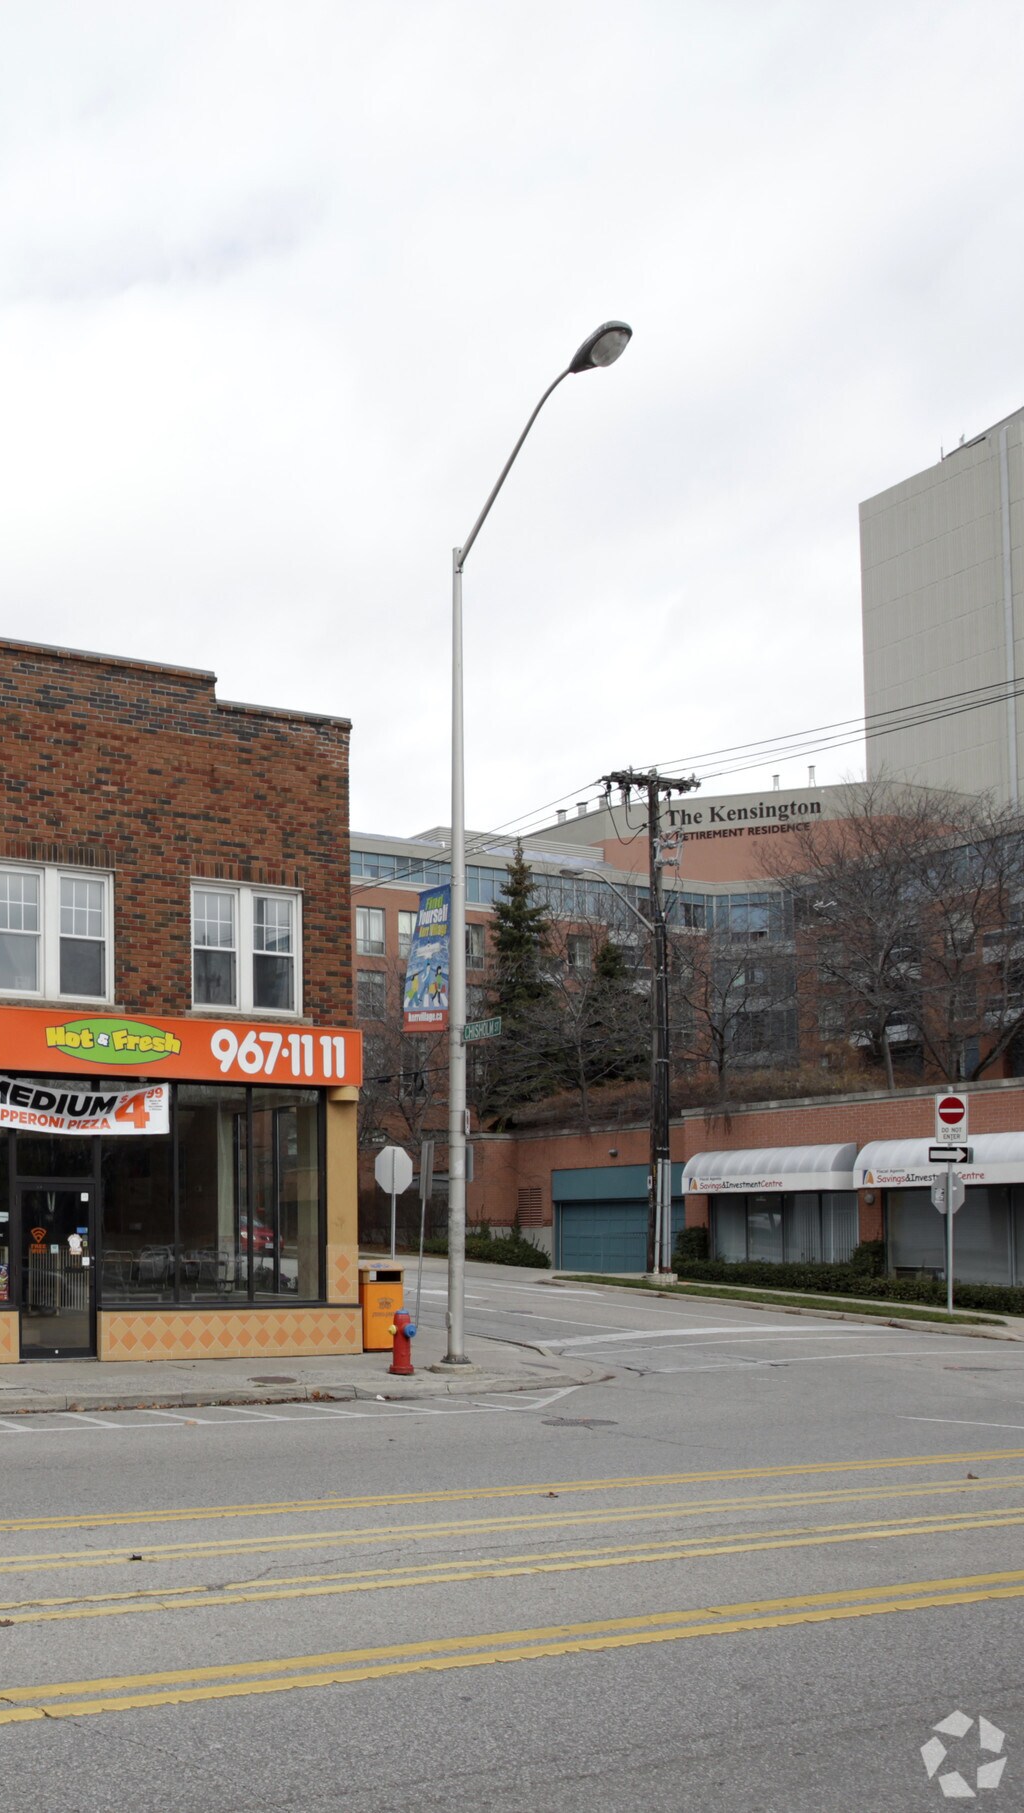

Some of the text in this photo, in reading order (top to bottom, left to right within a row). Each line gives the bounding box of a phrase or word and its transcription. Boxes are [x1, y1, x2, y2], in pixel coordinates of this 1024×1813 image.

[669, 801, 821, 826] The Kensington
[748, 822, 810, 836] RESIDENCE
[464, 1021, 494, 1039] CHISHOLM
[45, 1025, 182, 1055] Hot & Fresh
[67, 1118, 111, 1130] PIZZA
